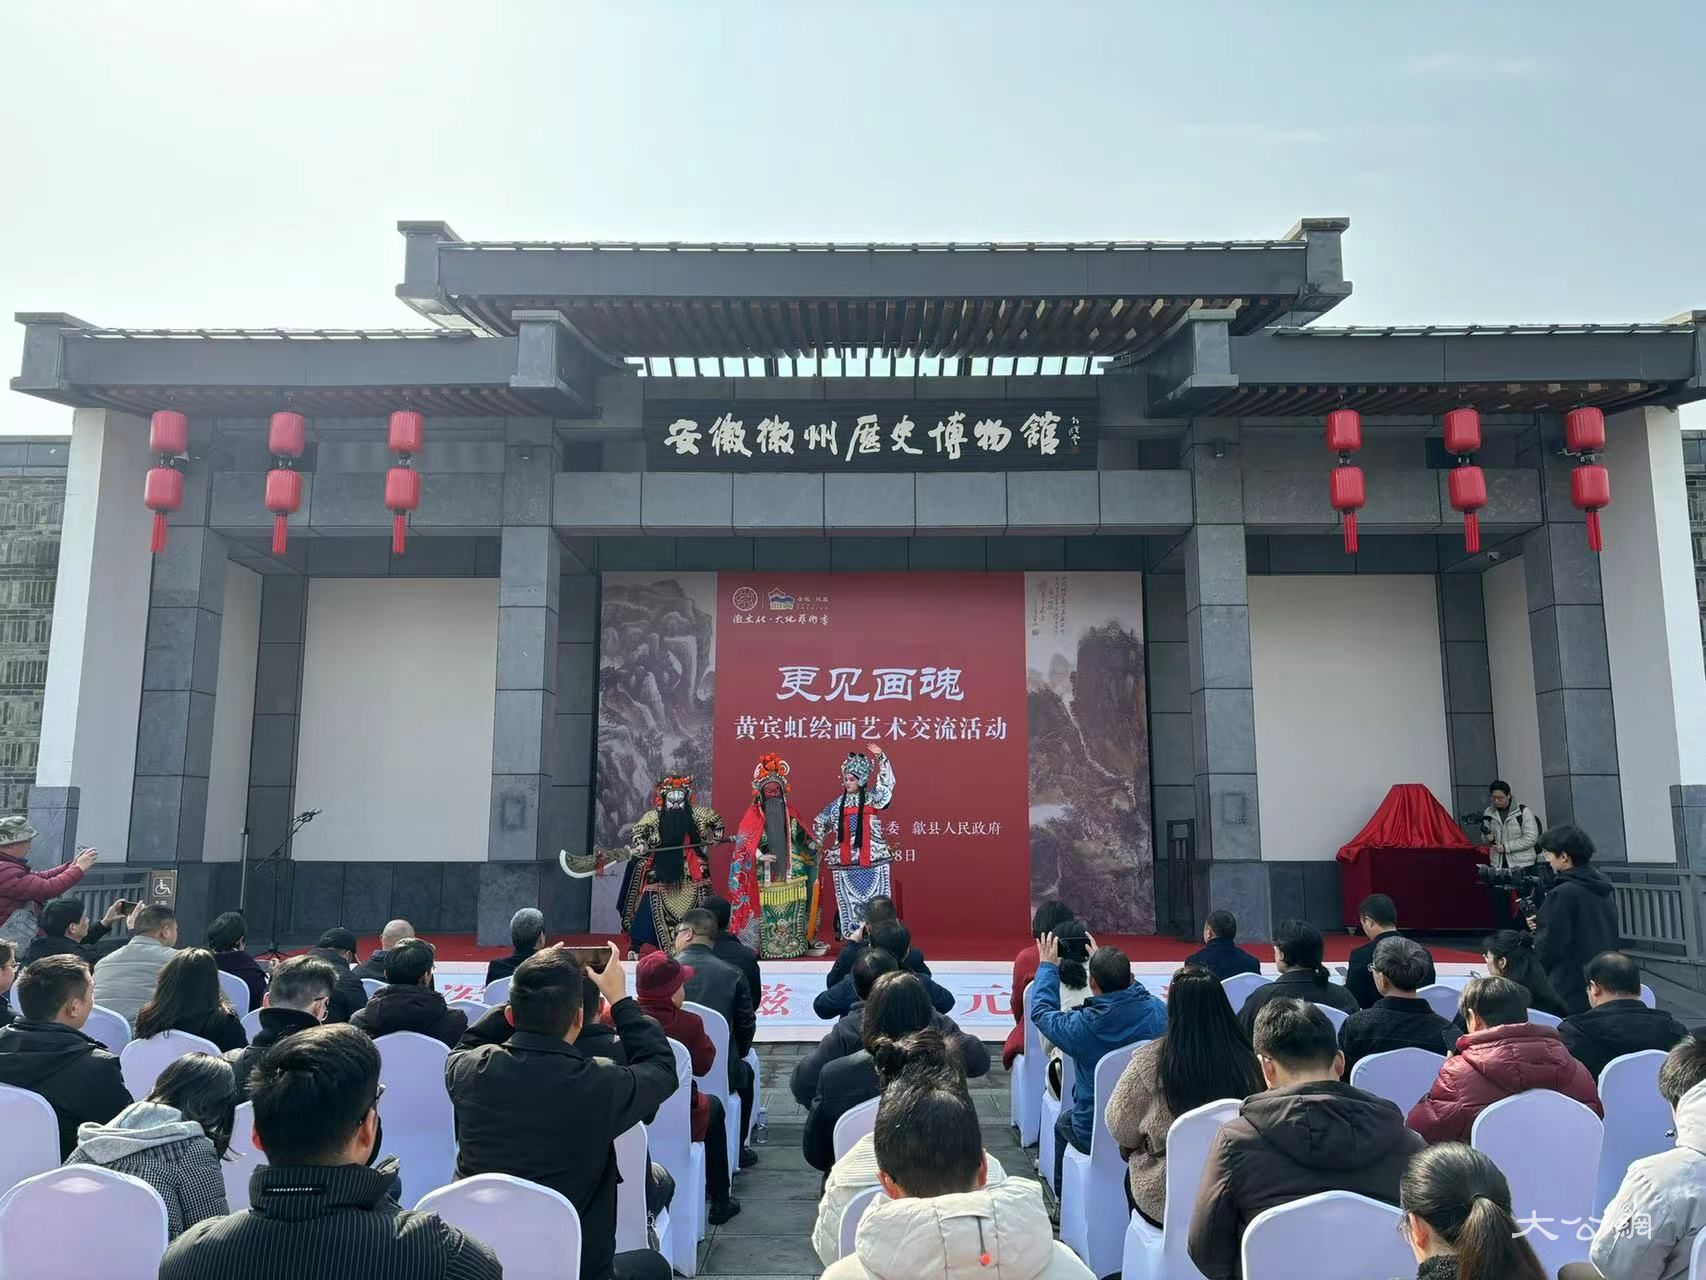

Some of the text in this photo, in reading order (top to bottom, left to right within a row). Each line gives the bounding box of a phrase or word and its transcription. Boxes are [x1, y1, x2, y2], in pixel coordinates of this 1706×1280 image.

[776, 666, 965, 704] 更见画魂
[734, 714, 1008, 741] 黄宾虹绘画艺术交流活动
[911, 820, 1002, 836] 歙县人民政府
